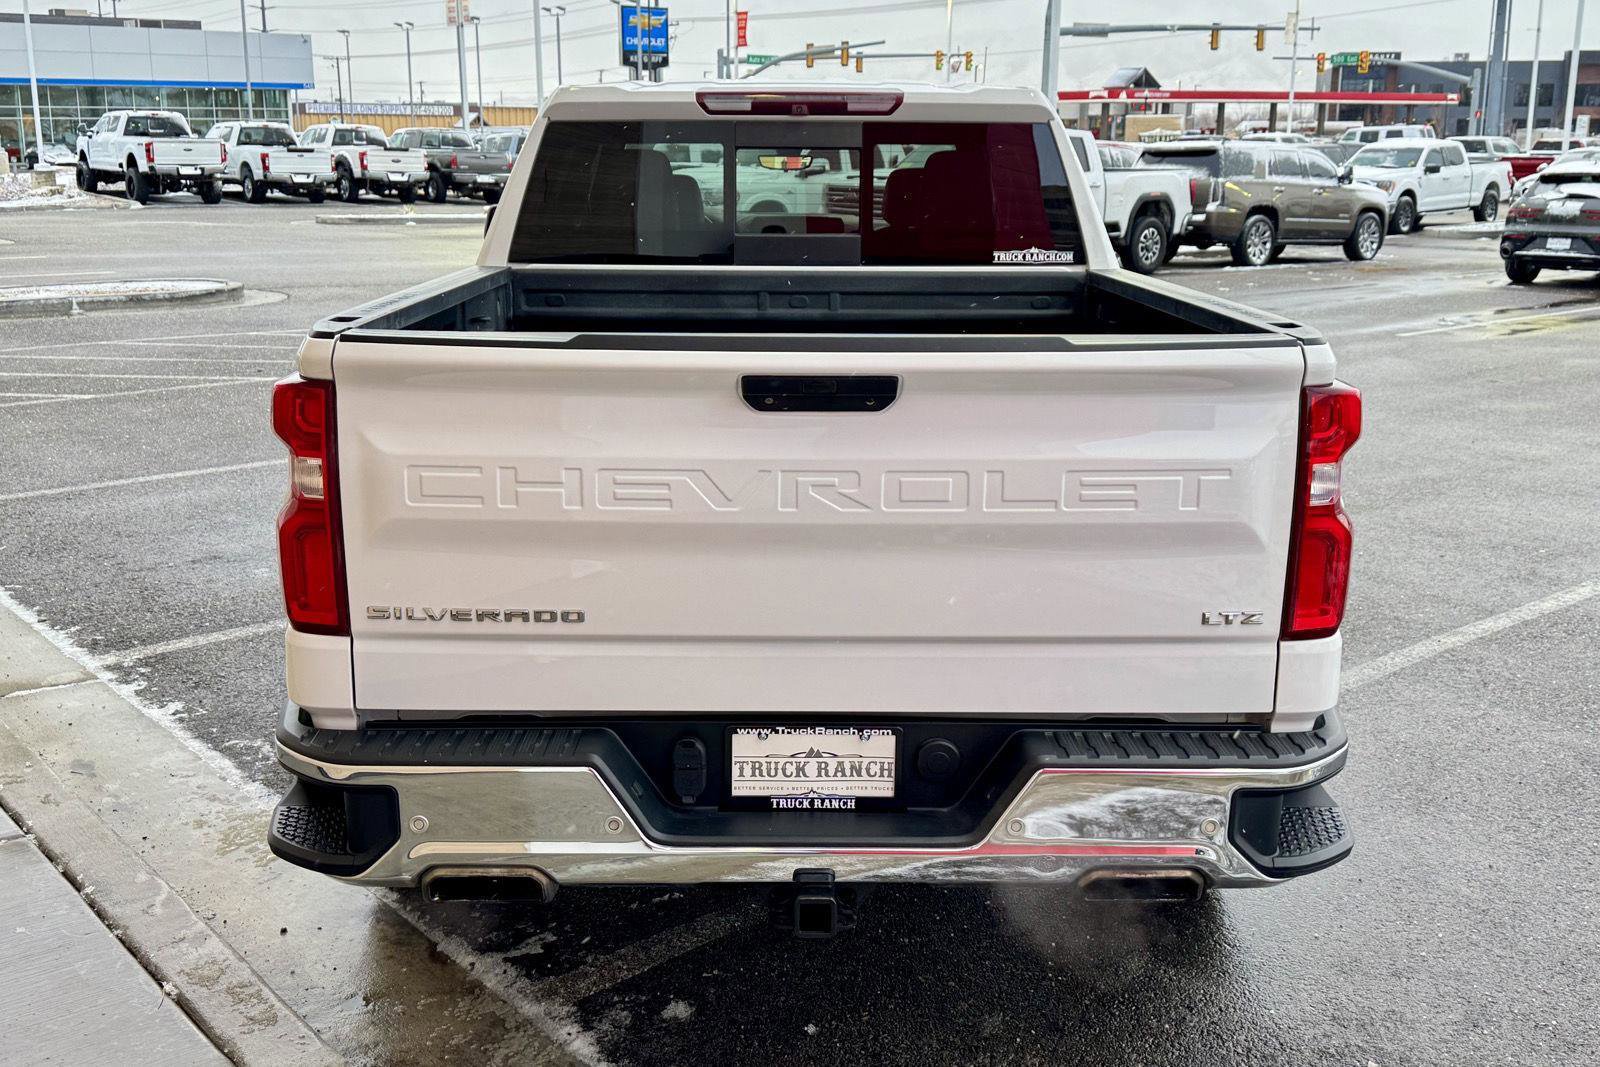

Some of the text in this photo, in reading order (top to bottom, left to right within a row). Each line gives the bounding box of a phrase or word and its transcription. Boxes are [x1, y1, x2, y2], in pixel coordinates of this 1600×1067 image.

[380, 105, 408, 114] SUPPLY
[993, 252, 1023, 261] TRUCK
[404, 464, 1232, 512] CHEVROLET
[366, 605, 585, 624] SILVERADO
[1201, 611, 1263, 625] LTZ
[736, 726, 892, 737] www.TruckRanch.com
[734, 761, 894, 779] TRUCK RANCH
[771, 798, 856, 809] TRUCK RANCH
